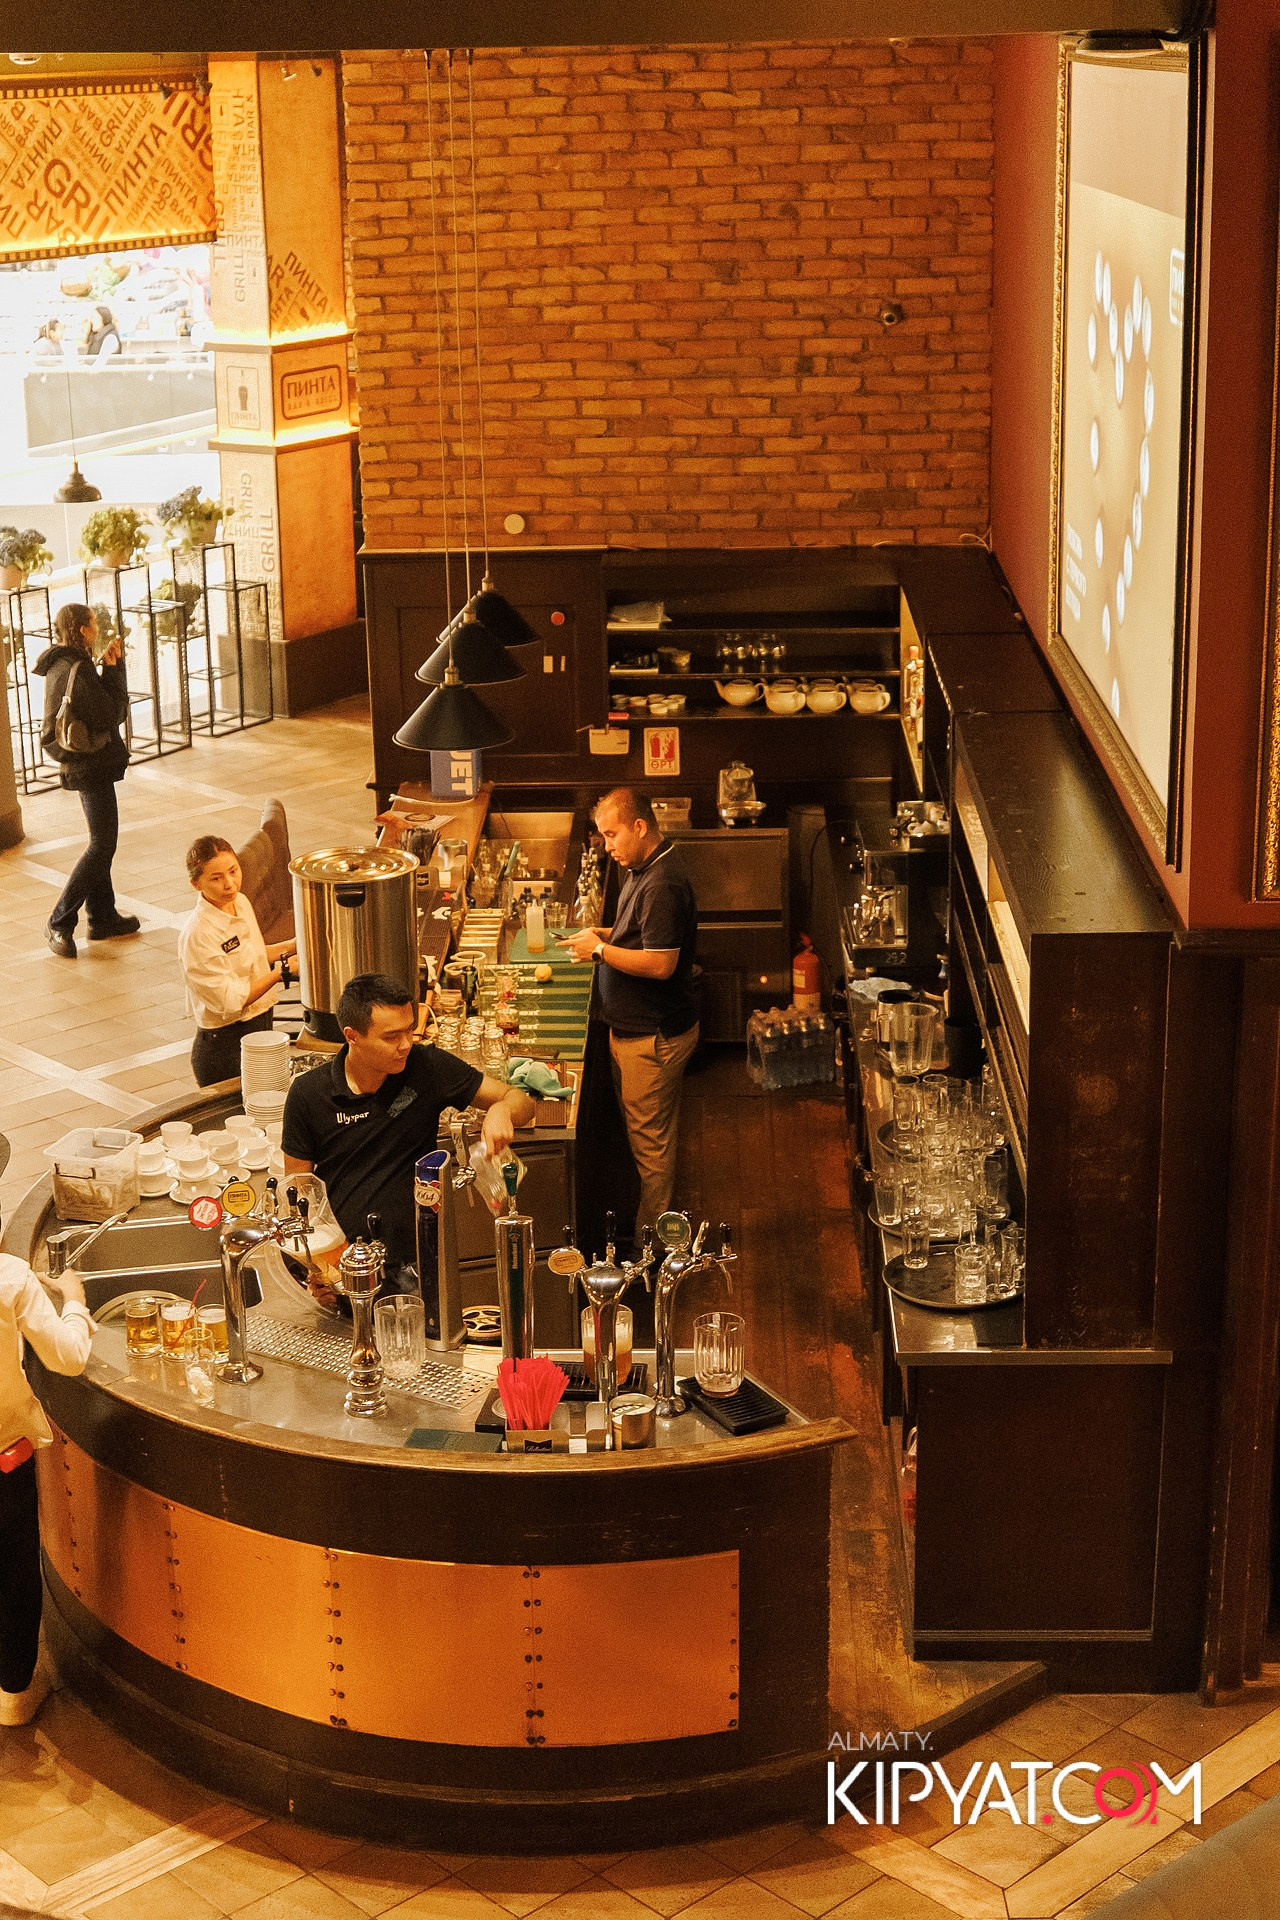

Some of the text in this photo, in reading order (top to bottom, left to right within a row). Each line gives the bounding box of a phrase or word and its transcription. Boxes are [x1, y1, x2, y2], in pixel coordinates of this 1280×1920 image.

[15, 114, 39, 148] BAR
[73, 119, 112, 174] ПИНТА
[99, 97, 134, 147] GRILL
[10, 117, 63, 190] ПИНТА
[103, 122, 168, 217] ПИНТА
[161, 158, 198, 209] ПИНТА
[233, 250, 246, 303] GRILL
[284, 250, 329, 315] ПИНТА
[287, 375, 337, 399] ПИНТА
[260, 507, 276, 573] GRILL
